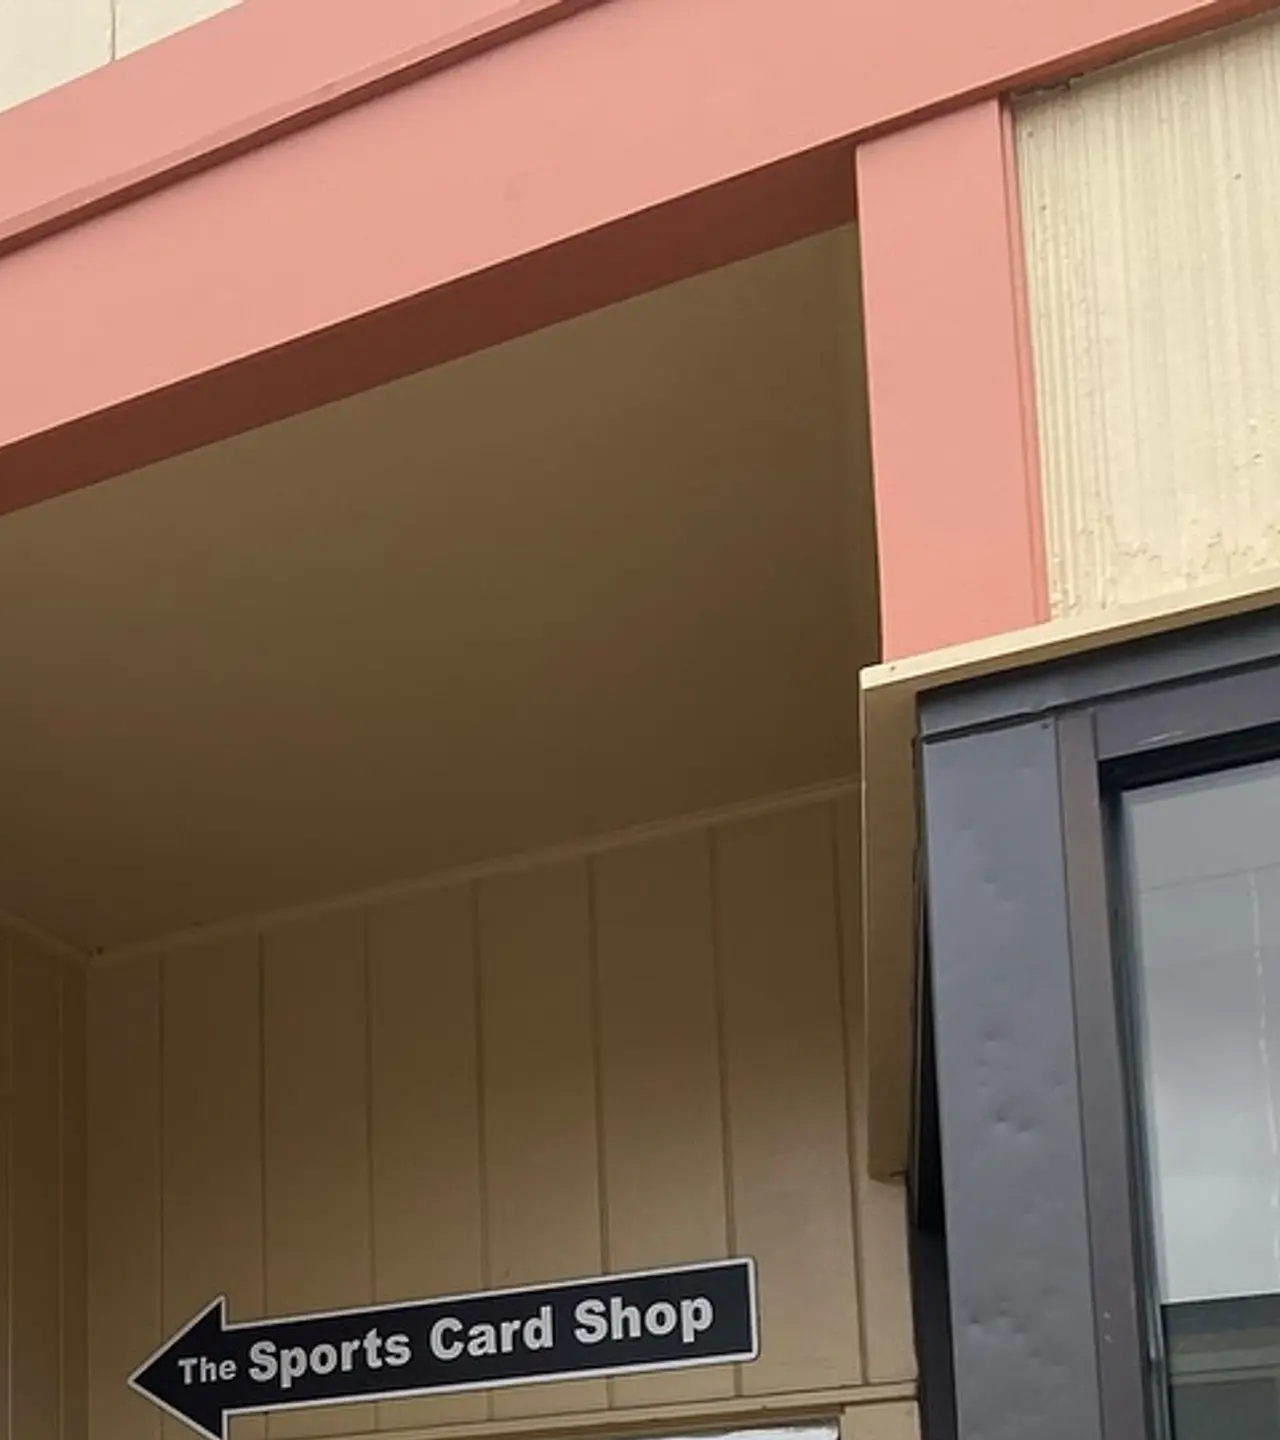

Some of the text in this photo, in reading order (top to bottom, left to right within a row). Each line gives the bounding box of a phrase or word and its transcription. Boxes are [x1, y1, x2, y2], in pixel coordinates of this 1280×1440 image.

[178, 1293, 714, 1389] The Sports Card Shop
